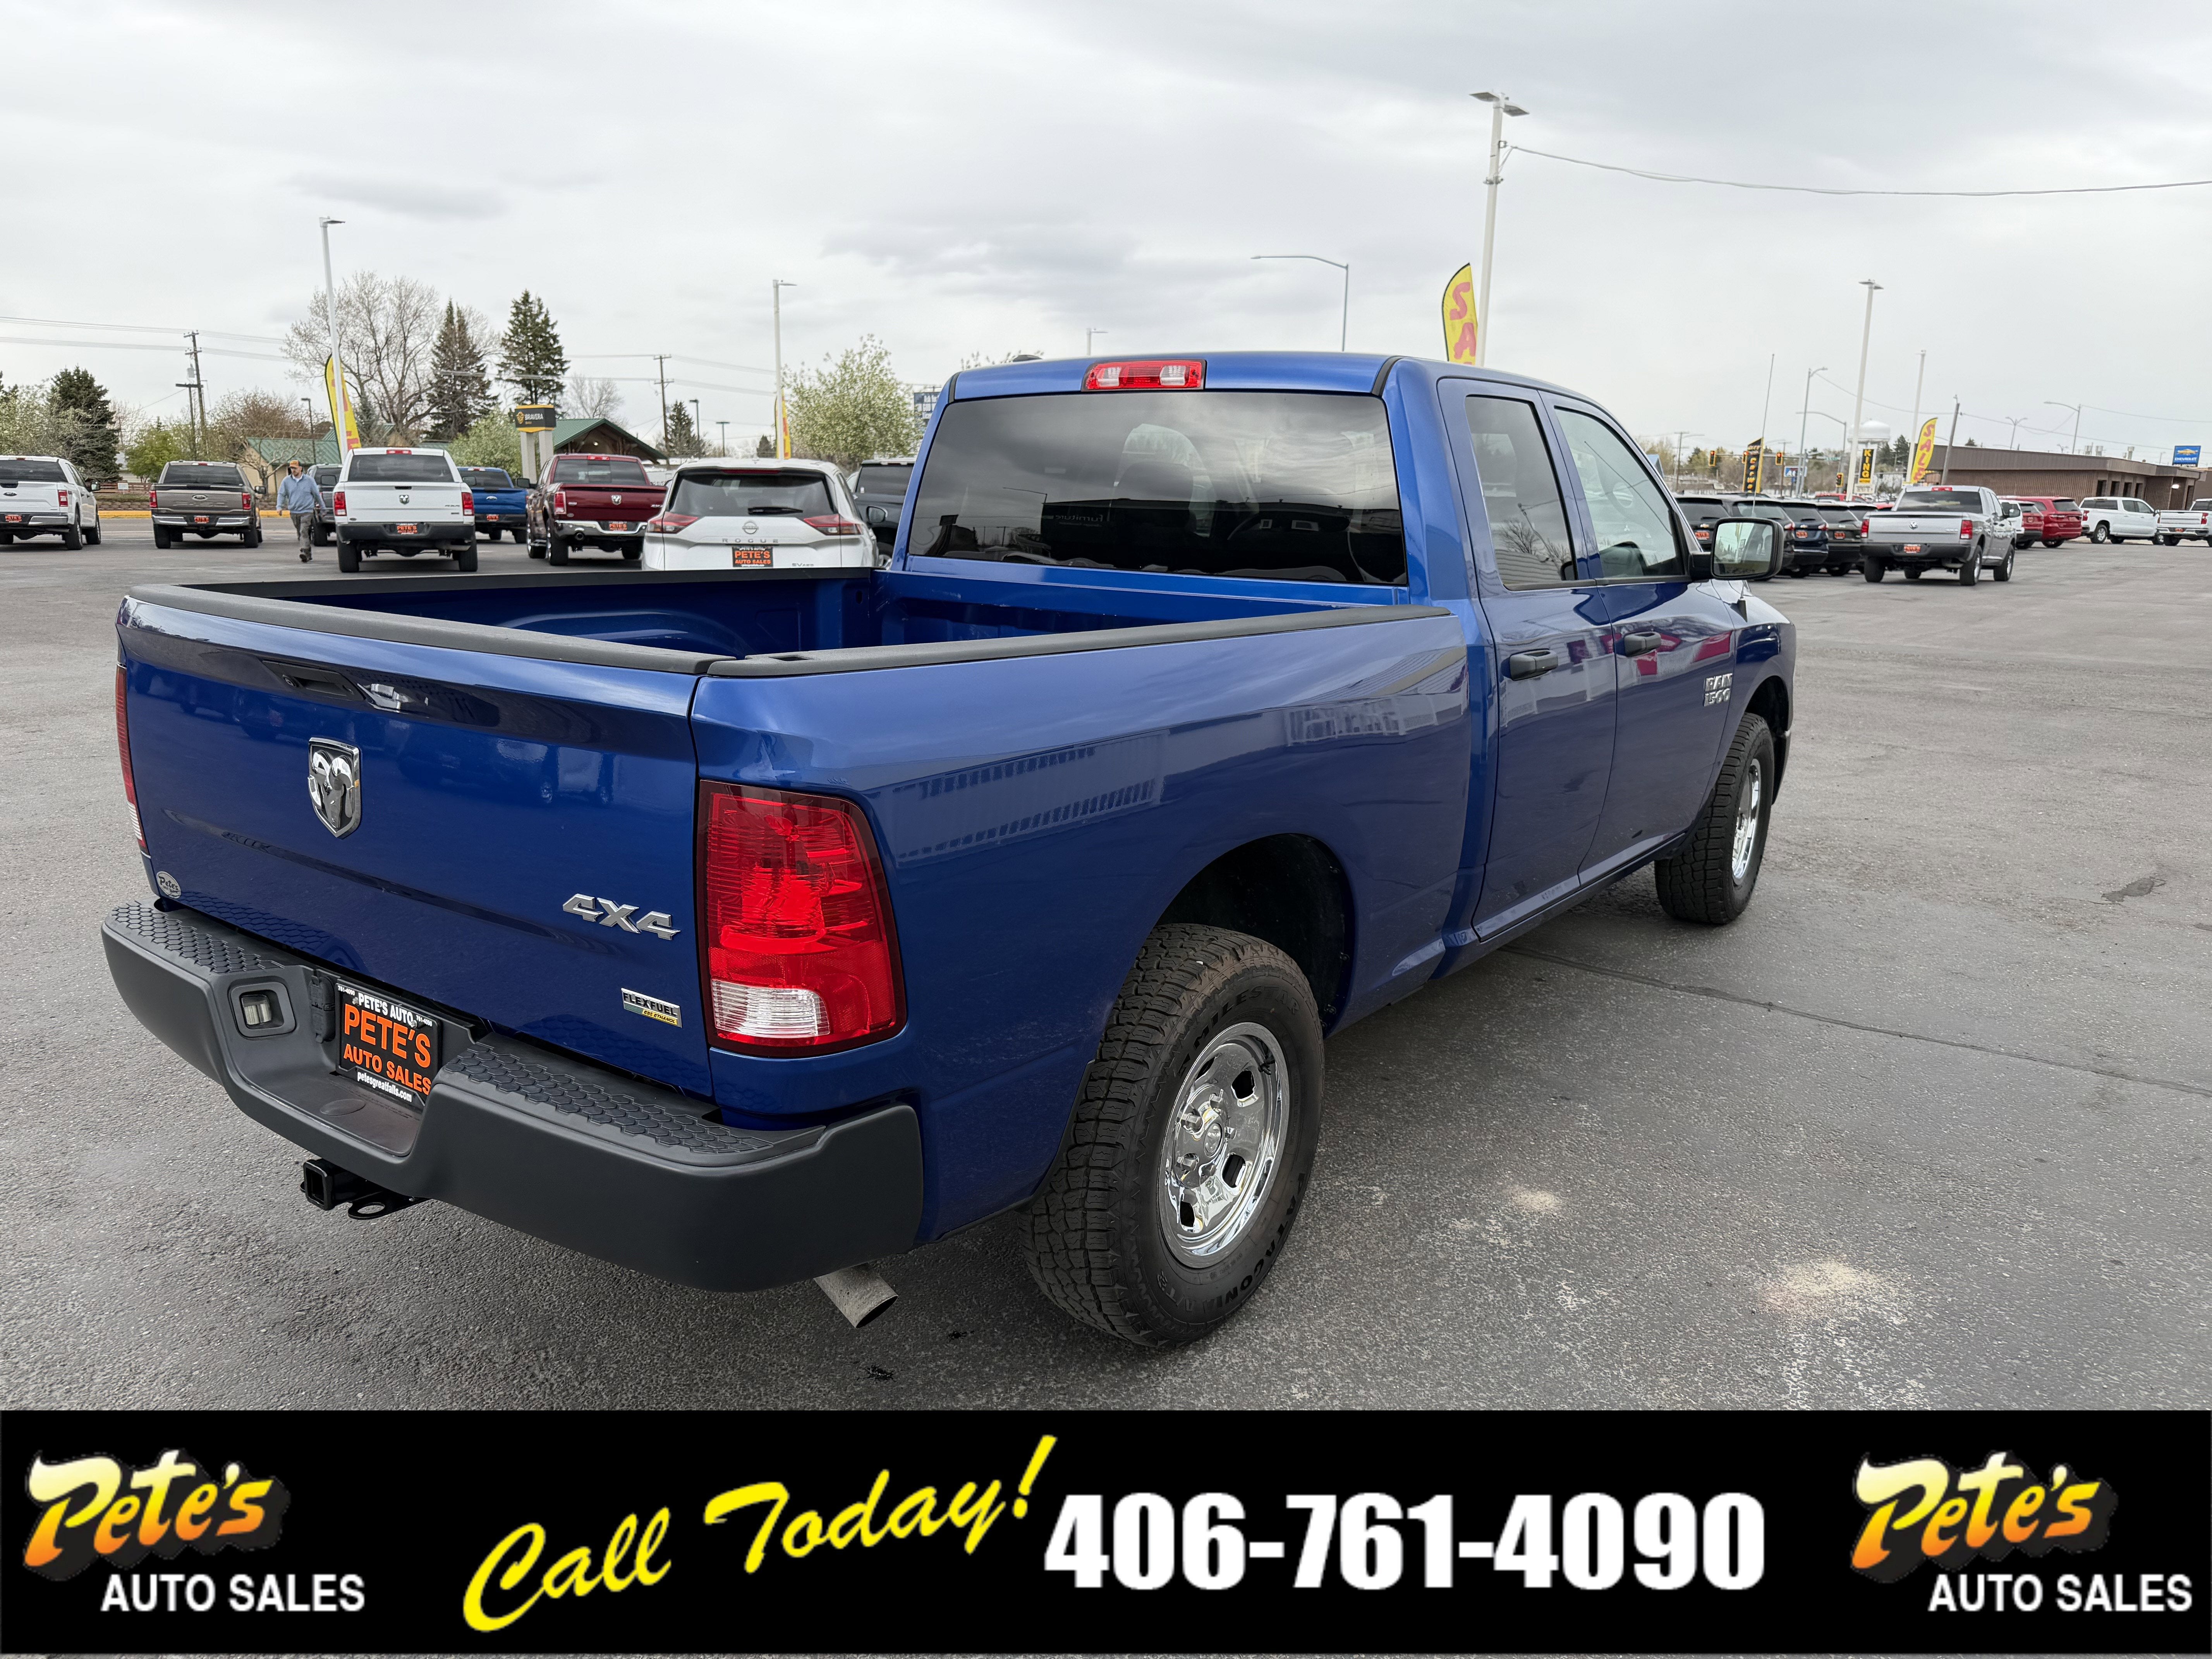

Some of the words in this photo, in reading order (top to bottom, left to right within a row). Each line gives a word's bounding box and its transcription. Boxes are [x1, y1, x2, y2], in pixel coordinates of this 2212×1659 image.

[1449, 282, 1476, 365] SA
[1862, 450, 1871, 478] KING
[358, 993, 388, 1016] PETE'S
[390, 1005, 414, 1028] AUTO
[654, 1013, 675, 1024] ETHANOL
[344, 1003, 431, 1068] PETE'S
[343, 1043, 382, 1073] AUTO
[386, 1061, 431, 1096] SALES
[357, 1072, 412, 1103] petesgreatfalls.com
